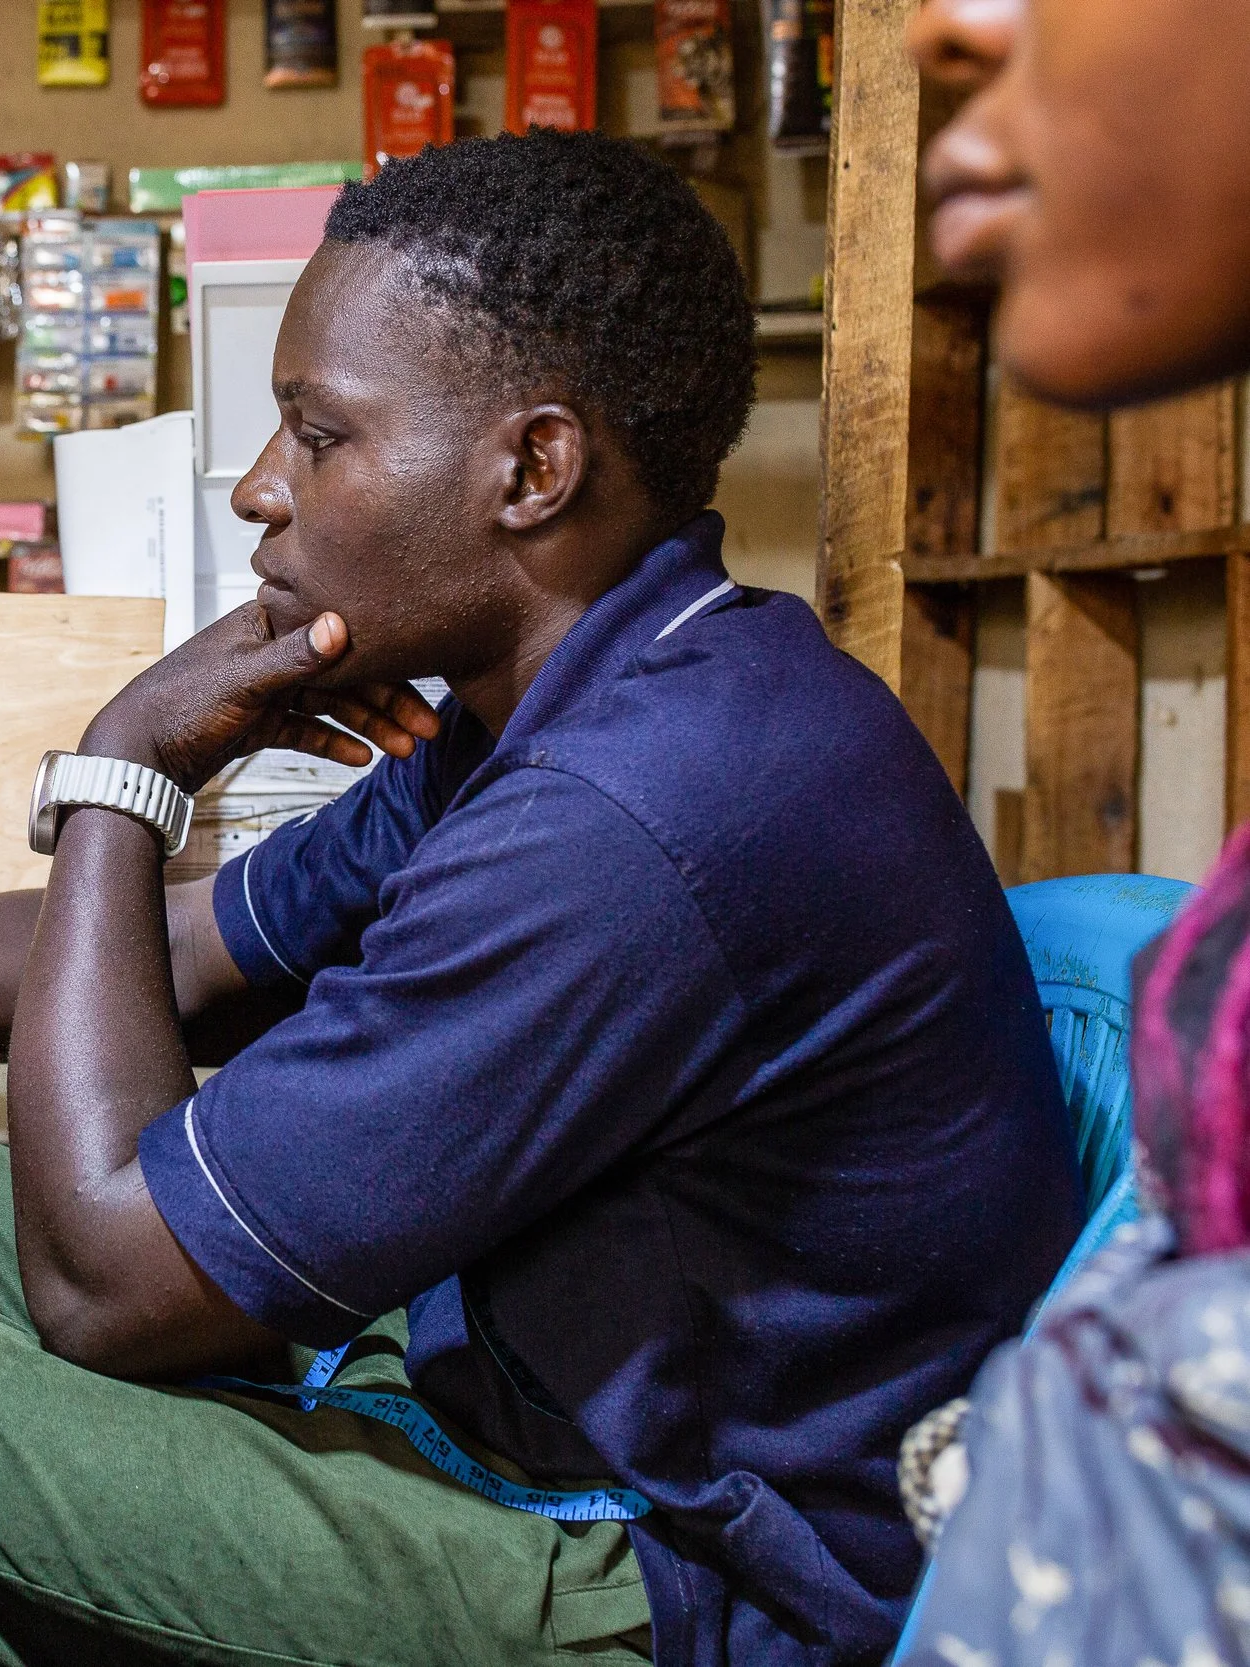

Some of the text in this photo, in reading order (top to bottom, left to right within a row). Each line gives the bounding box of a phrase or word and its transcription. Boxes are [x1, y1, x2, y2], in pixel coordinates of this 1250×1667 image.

[374, 1398, 411, 1415] 58
[422, 1426, 451, 1458] 57
[469, 1464, 502, 1492] 56
[526, 1492, 561, 1507] 55
[588, 1491, 625, 1507] 54
